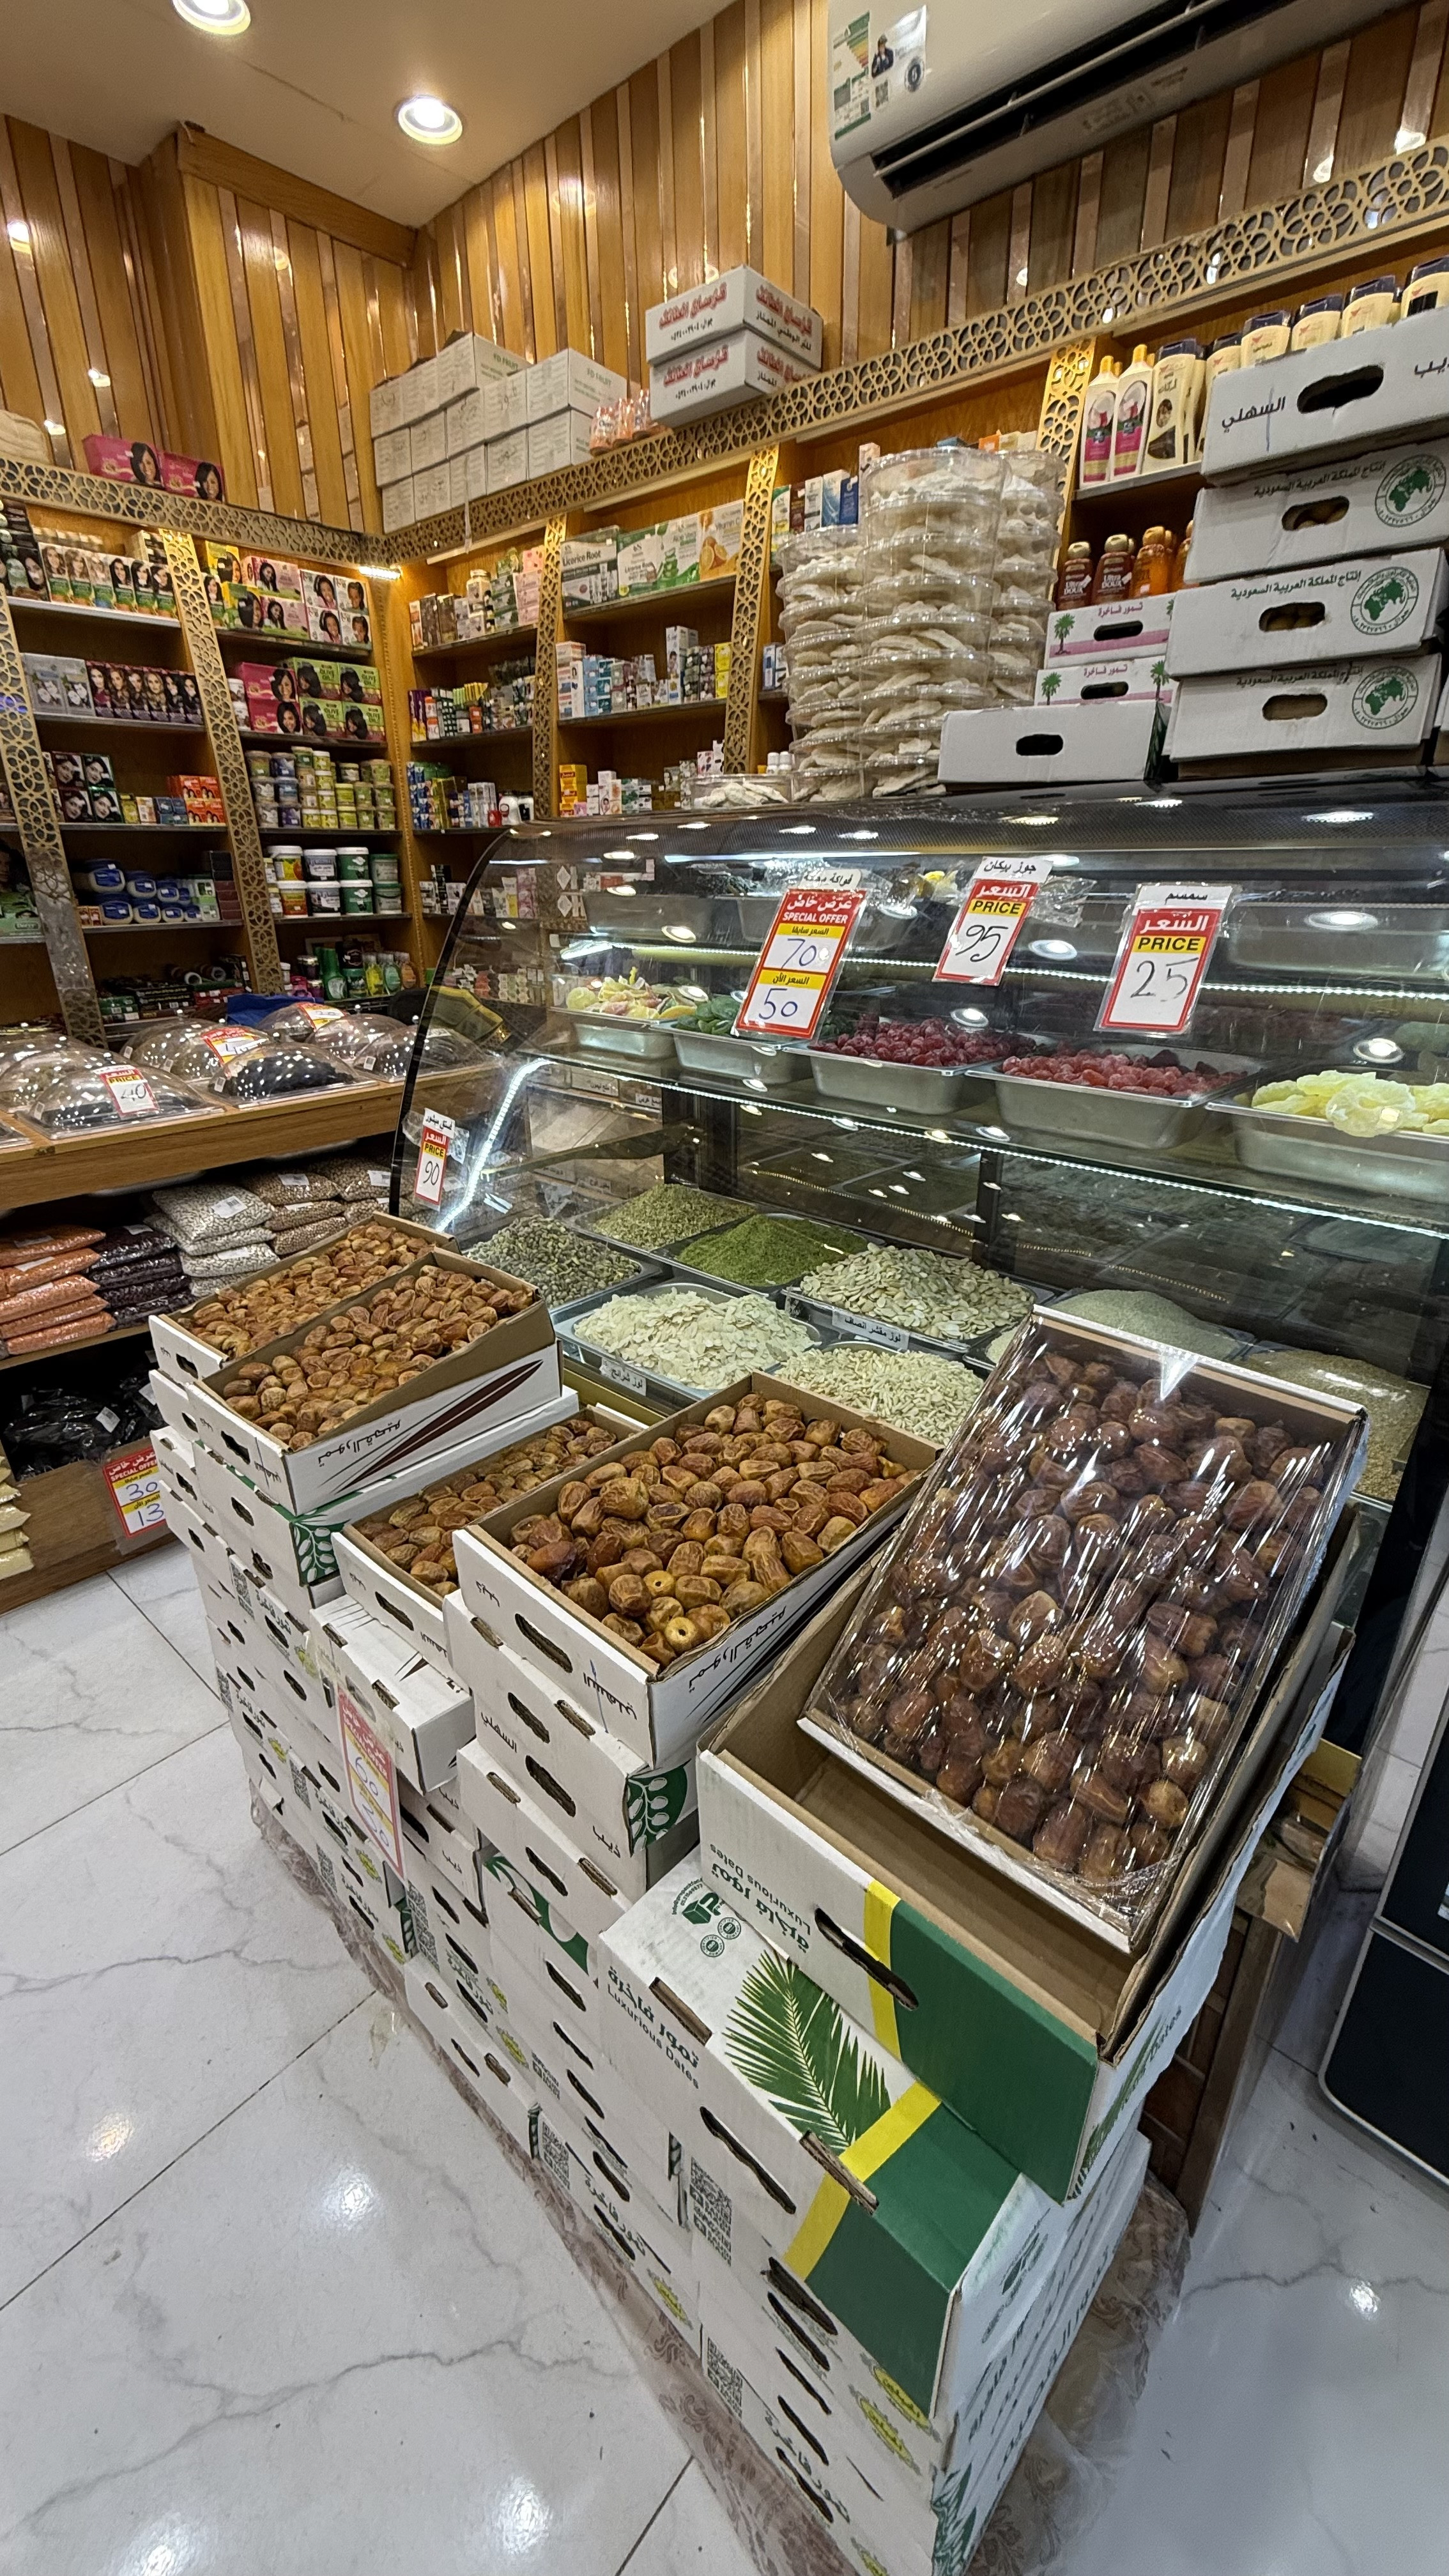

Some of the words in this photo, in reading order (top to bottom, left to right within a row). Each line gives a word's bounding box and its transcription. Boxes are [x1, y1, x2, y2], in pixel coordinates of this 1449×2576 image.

[1222, 396, 1286, 433] السهلي
[586, 550, 601, 562] Root
[1230, 583, 1273, 601] السعودية
[1274, 579, 1307, 595] العربية
[984, 860, 1011, 872] بيكان
[1015, 861, 1037, 875] جوز
[976, 884, 1032, 898] السعر
[1165, 892, 1208, 906] سمسم
[782, 912, 817, 923] SPECIAL
[818, 913, 848, 924] OFFER
[972, 900, 1022, 914] PRICE
[808, 926, 829, 936] السعر
[781, 938, 817, 969] 70
[955, 924, 1009, 962] 95
[1137, 937, 1200, 951] PRICE
[786, 976, 809, 985] السعر
[1130, 957, 1199, 1002] 25
[758, 988, 798, 1020] 50
[109, 1075, 138, 1084] PRICE
[425, 1131, 447, 1146] السعر
[425, 1143, 444, 1158] PRICE
[423, 1160, 440, 1186] 90
[111, 1466, 139, 1481] SPECIAL
[139, 1460, 158, 1471] OFFE
[126, 1482, 158, 1501] 30
[138, 1503, 164, 1526] 13
[583, 1672, 638, 1721] السهلي
[481, 1712, 517, 1753] السهلي
[356, 1758, 378, 1797] 60
[592, 1825, 620, 1858] ذيب
[710, 1843, 743, 1878] Dates
[711, 1863, 751, 1900] تمور
[756, 1898, 809, 1954] فاخرة
[746, 1873, 811, 1935] Luxurious
[608, 1966, 654, 2024] فاخرة
[608, 1983, 663, 2049] Luxurious
[666, 2046, 699, 2089] Dates
[660, 2023, 699, 2069] تمور
